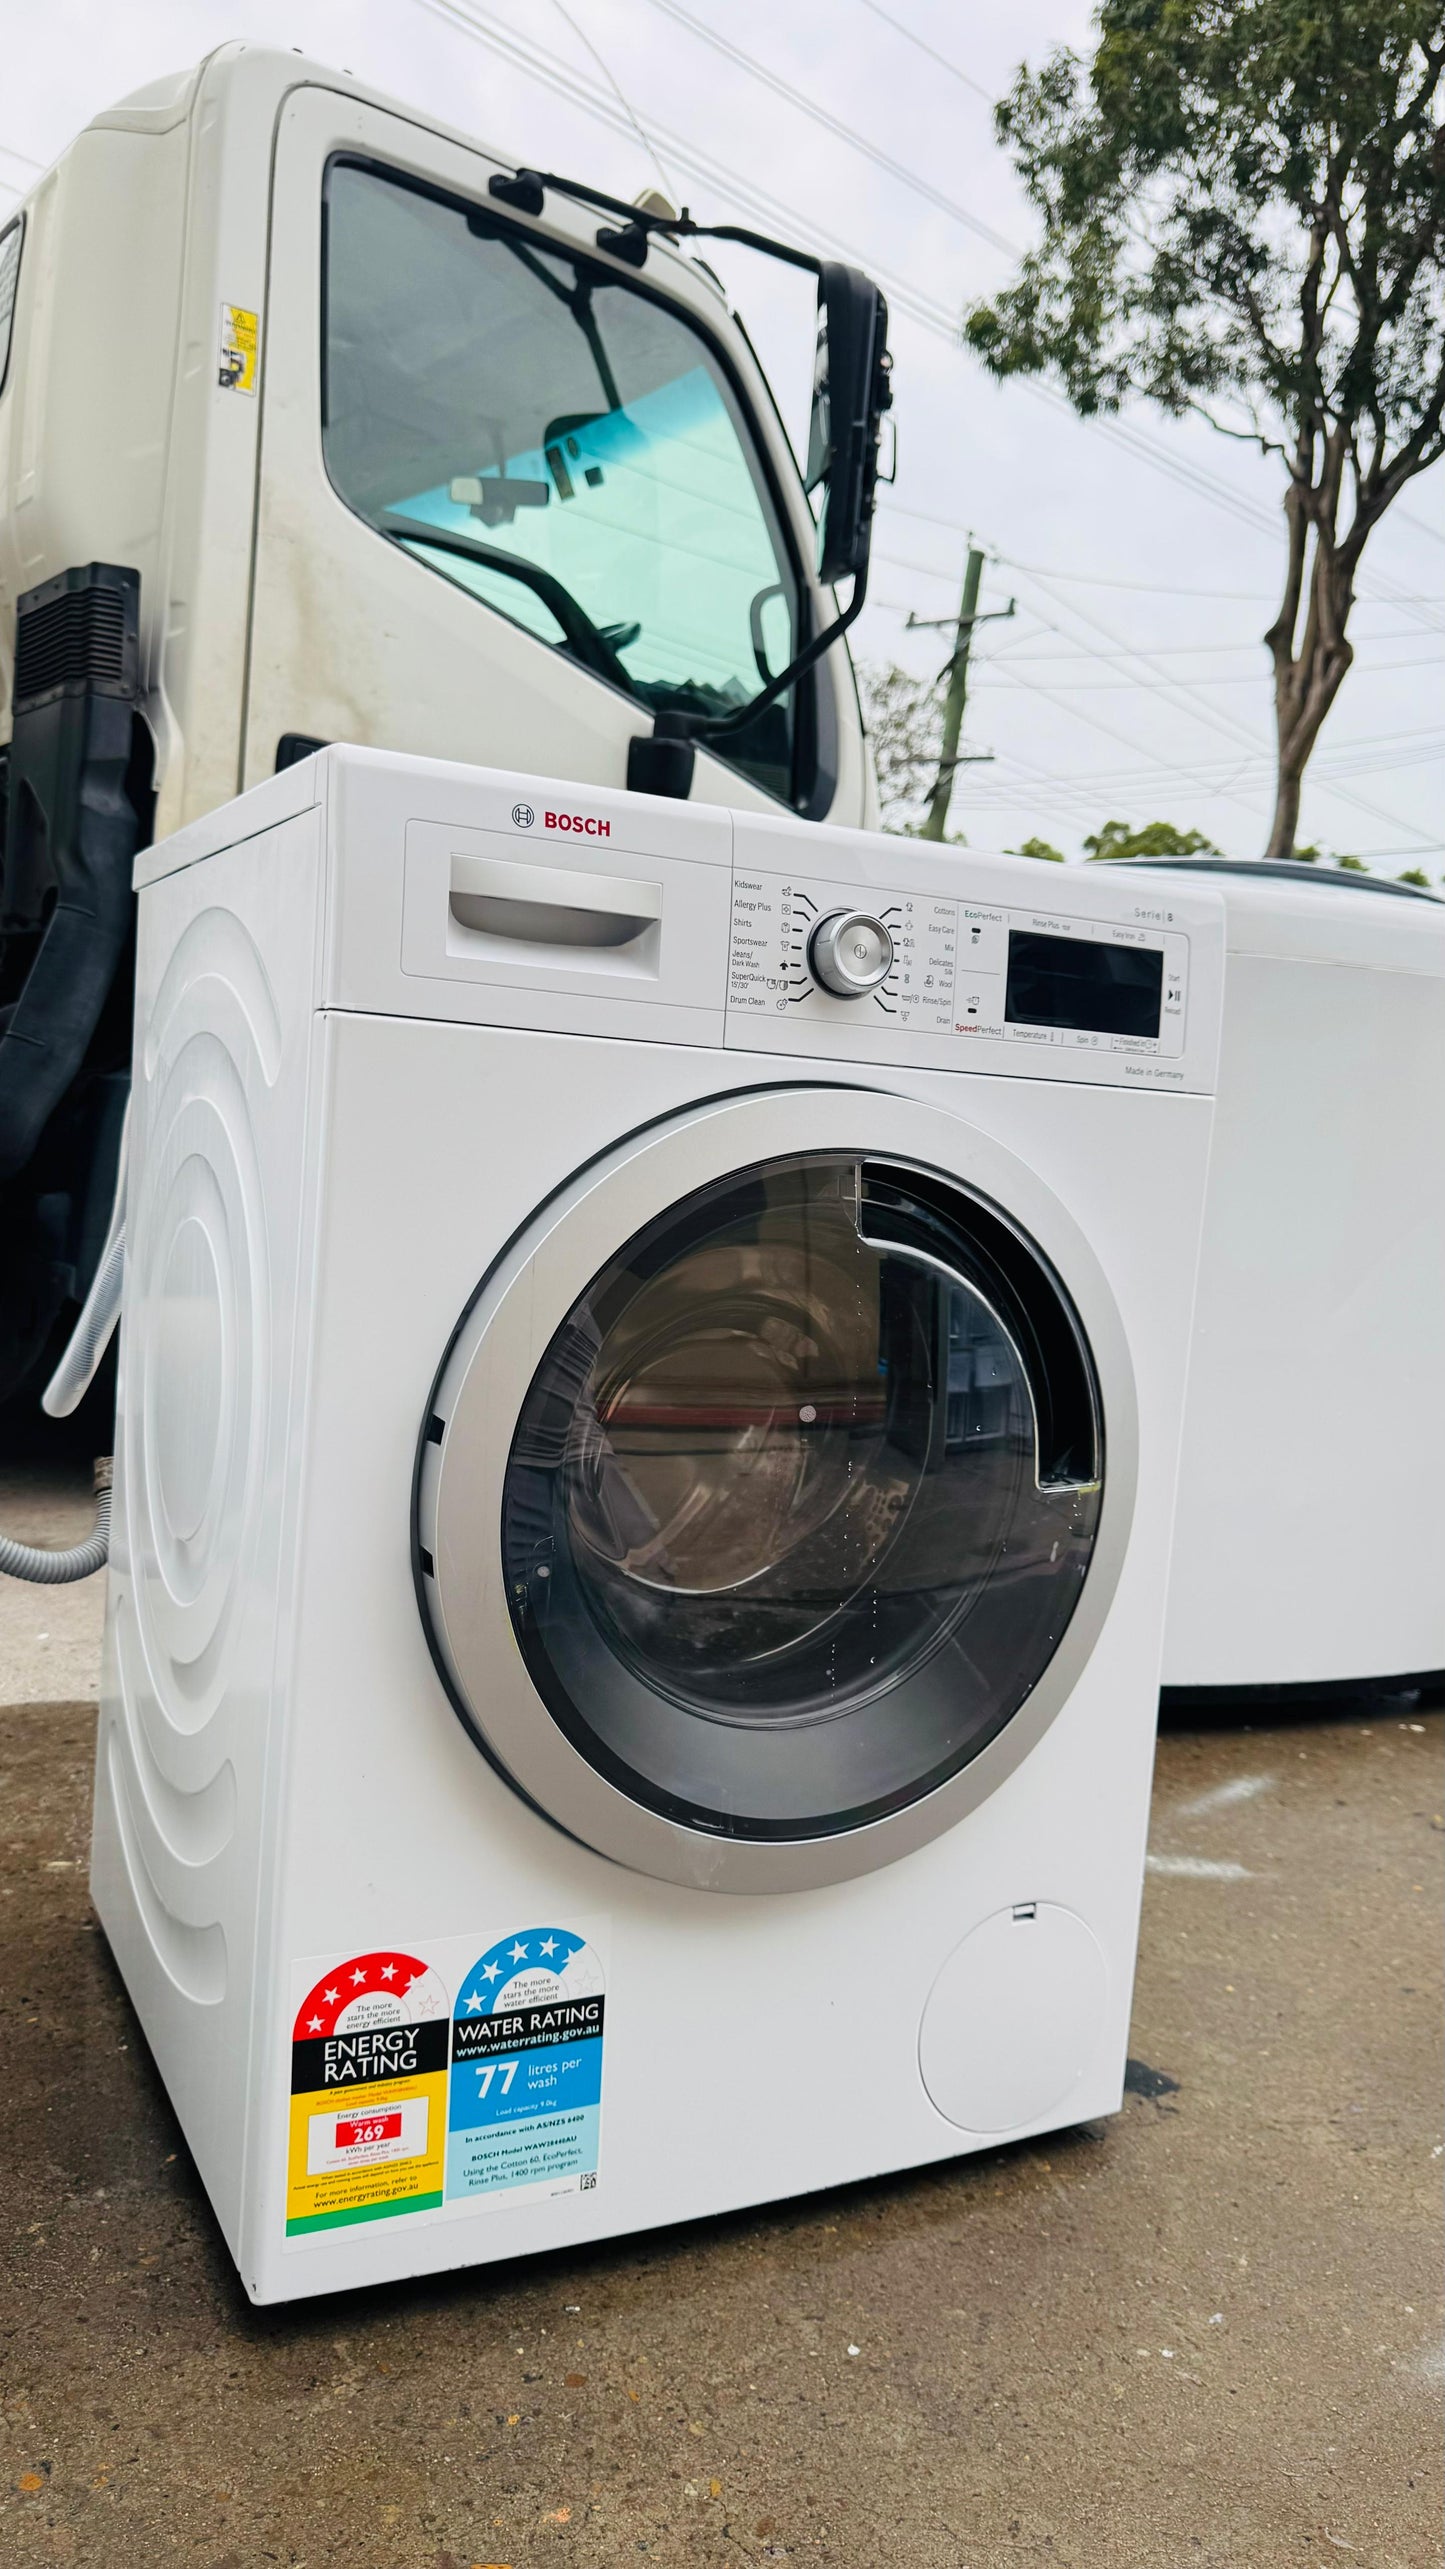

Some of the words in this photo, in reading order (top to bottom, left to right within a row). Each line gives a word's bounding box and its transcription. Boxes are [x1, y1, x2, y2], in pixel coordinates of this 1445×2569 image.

[544, 811, 611, 837] BOSCH
[734, 880, 763, 891] Kidswear
[734, 899, 756, 911] Allergy
[758, 902, 772, 912] Plus
[964, 910, 1002, 922] EcoPerfect
[1134, 908, 1161, 921] Serie
[1167, 913, 1174, 922] 8
[733, 918, 752, 928] Shirts
[928, 924, 941, 934] Easy
[942, 926, 955, 934] Care
[733, 936, 768, 947] Sportswear
[732, 950, 754, 960] Jeans/
[732, 958, 745, 967] Dark
[745, 960, 760, 968] Wash
[732, 971, 766, 982] SuperQuick
[939, 980, 952, 988] Wool
[730, 996, 748, 1004] Drum
[748, 997, 766, 1006] Clean
[954, 1023, 1002, 1036] SpeedPerfect
[1012, 1029, 1047, 1040] Temperature
[1126, 1066, 1144, 1076] Made
[1146, 1068, 1152, 1076] in
[1154, 1069, 1184, 1080] Germany
[513, 1980, 528, 1990] The
[530, 1978, 552, 1987] more
[503, 1990, 522, 1999] stars
[524, 1988, 536, 1996] the
[538, 1984, 560, 1994] more
[372, 2002, 392, 2010] more
[504, 2000, 526, 2008] water
[528, 1993, 558, 2004] efficient
[347, 2014, 365, 2022] stars
[366, 2011, 378, 2019] the
[380, 2008, 400, 2016] more
[346, 2021, 370, 2030] energy
[372, 2015, 401, 2026] efficient
[458, 2016, 524, 2042] WATER
[530, 2004, 599, 2031] RATING
[324, 2028, 420, 2062] ENERGY
[456, 2024, 600, 2058] www.waterrating.gov.au
[324, 2050, 418, 2084] RATING
[528, 2062, 558, 2076] litres
[561, 2058, 582, 2073] per
[475, 2060, 520, 2099] 77
[528, 2075, 557, 2090] wash
[337, 2111, 359, 2120] Energy
[361, 2104, 402, 2116] consumption
[496, 2108, 512, 2116] Load
[350, 2120, 370, 2128] Warm
[373, 2116, 389, 2124] wash
[354, 2124, 384, 2144] 269
[465, 2136, 473, 2144] In
[474, 2128, 517, 2142] accordance
[518, 2125, 535, 2134] with
[346, 2146, 362, 2154] kWh
[364, 2145, 374, 2153] per
[377, 2142, 391, 2150] year
[471, 2151, 500, 2162] BOSCH
[501, 2146, 523, 2156] Model
[463, 2168, 484, 2178] Using
[500, 2158, 528, 2170] Cotton
[468, 2178, 489, 2187] Rinse
[511, 2168, 528, 2179] 1400
[530, 2166, 546, 2176] rpm
[547, 2160, 578, 2172] program
[313, 2183, 419, 2208] www.energyrating.gov.au
[315, 2192, 327, 2200] For
[330, 2188, 348, 2197] more
[392, 2177, 408, 2185] refer
